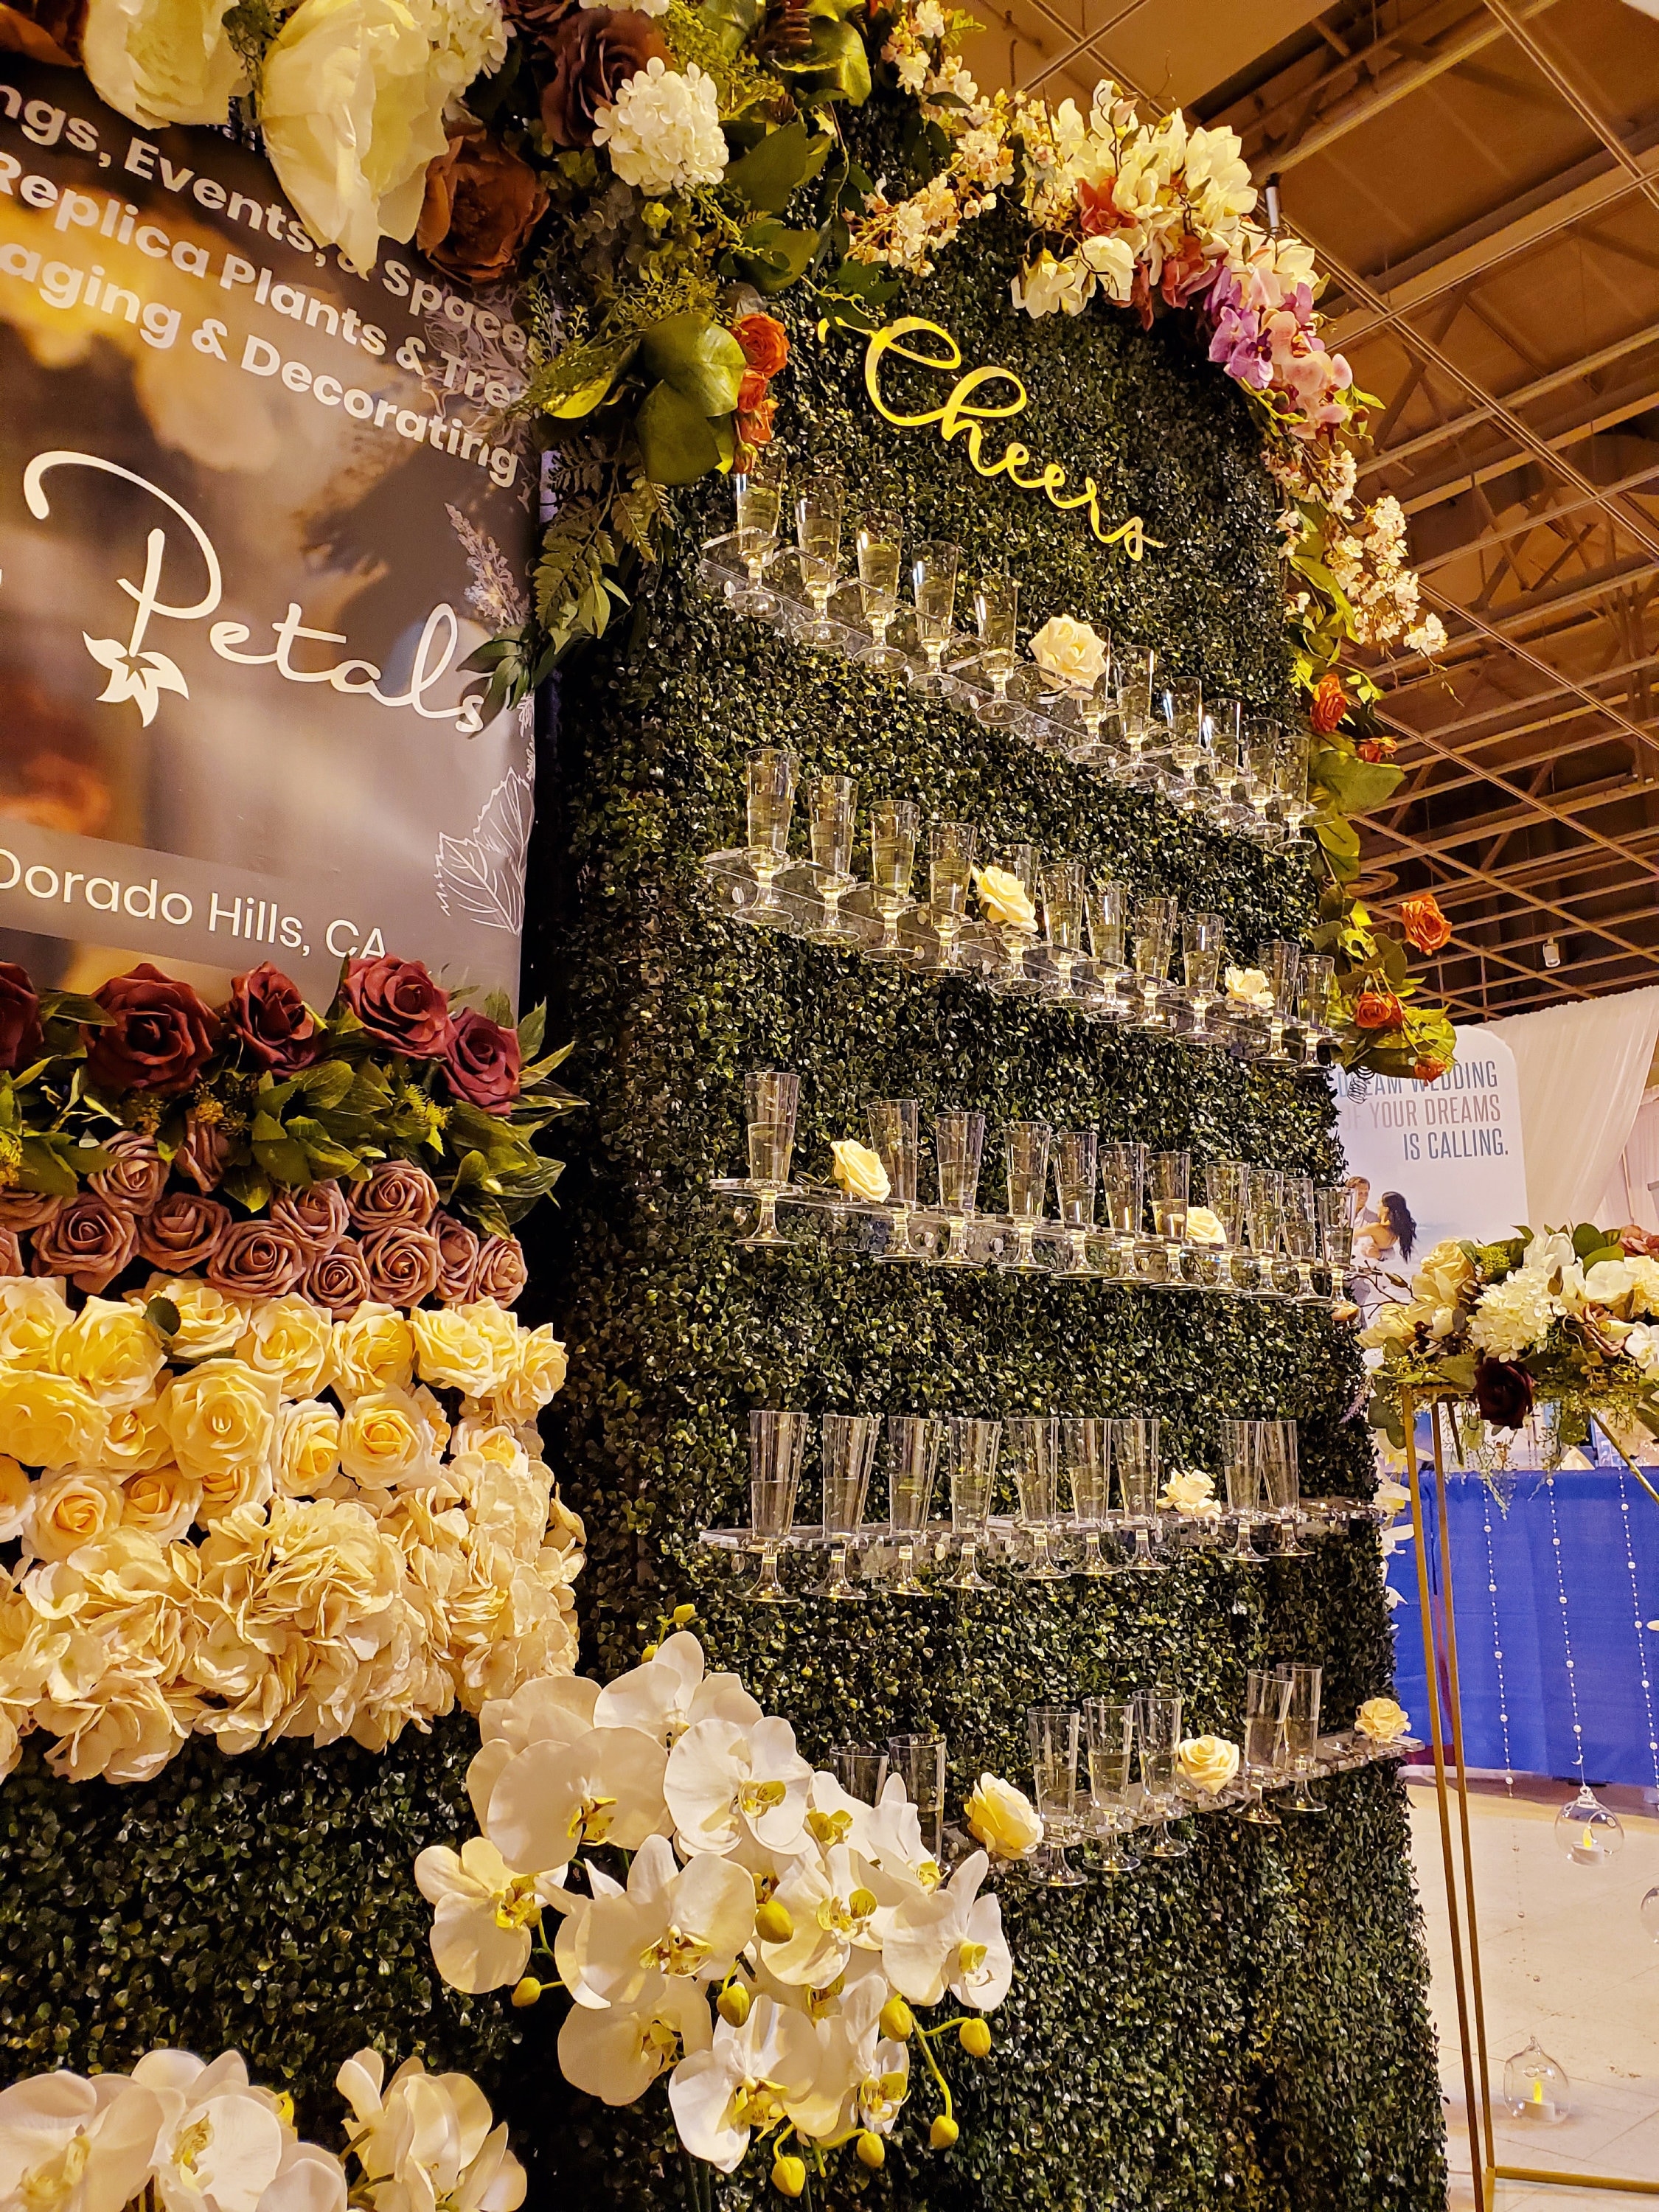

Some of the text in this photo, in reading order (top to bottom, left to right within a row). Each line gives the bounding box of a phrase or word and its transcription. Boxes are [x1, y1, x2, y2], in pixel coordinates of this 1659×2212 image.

[0, 150, 512, 408] Replica Plants & Tre
[124, 136, 327, 268] Events,
[381, 259, 527, 352] Space
[0, 243, 518, 488] aging & Decorating
[817, 316, 1168, 562] Cheers
[23, 451, 485, 734] Petals
[0, 848, 386, 959] Dorado Hills, CA
[1338, 1071, 1402, 1098] DAM
[1369, 1099, 1418, 1130] YOUR
[1425, 1093, 1501, 1126] DREAMS
[1403, 1128, 1509, 1161] IS CALLING.
